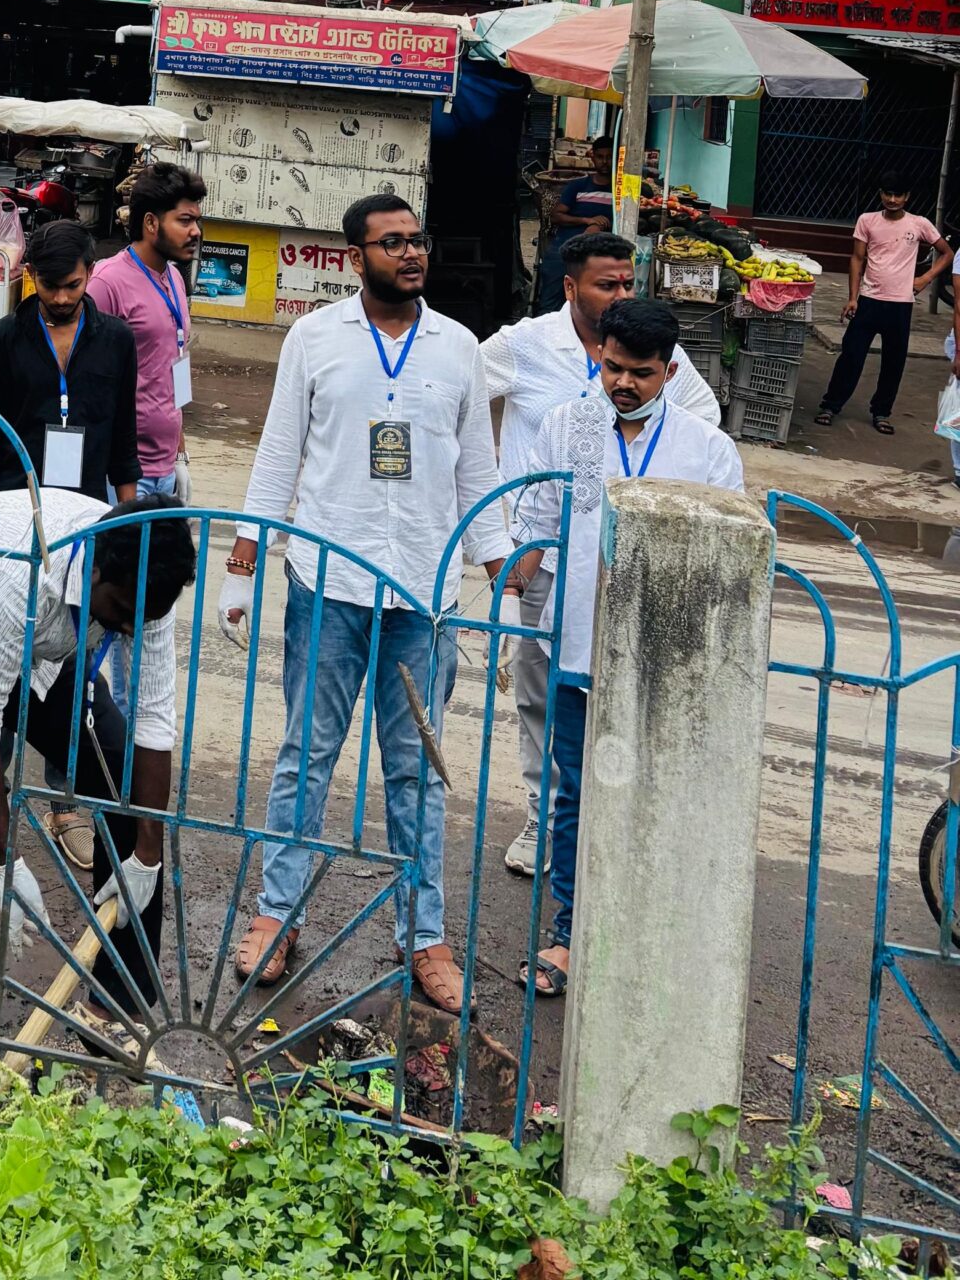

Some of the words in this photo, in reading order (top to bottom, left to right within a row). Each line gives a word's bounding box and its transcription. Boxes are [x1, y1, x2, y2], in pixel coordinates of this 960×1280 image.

[167, 10, 190, 35] শ্রী
[192, 18, 227, 44] কৃষ্ণ
[232, 20, 266, 41] পান
[229, 248, 247, 257] CANCER
[280, 243, 297, 266] ও
[321, 282, 342, 295] পাতা
